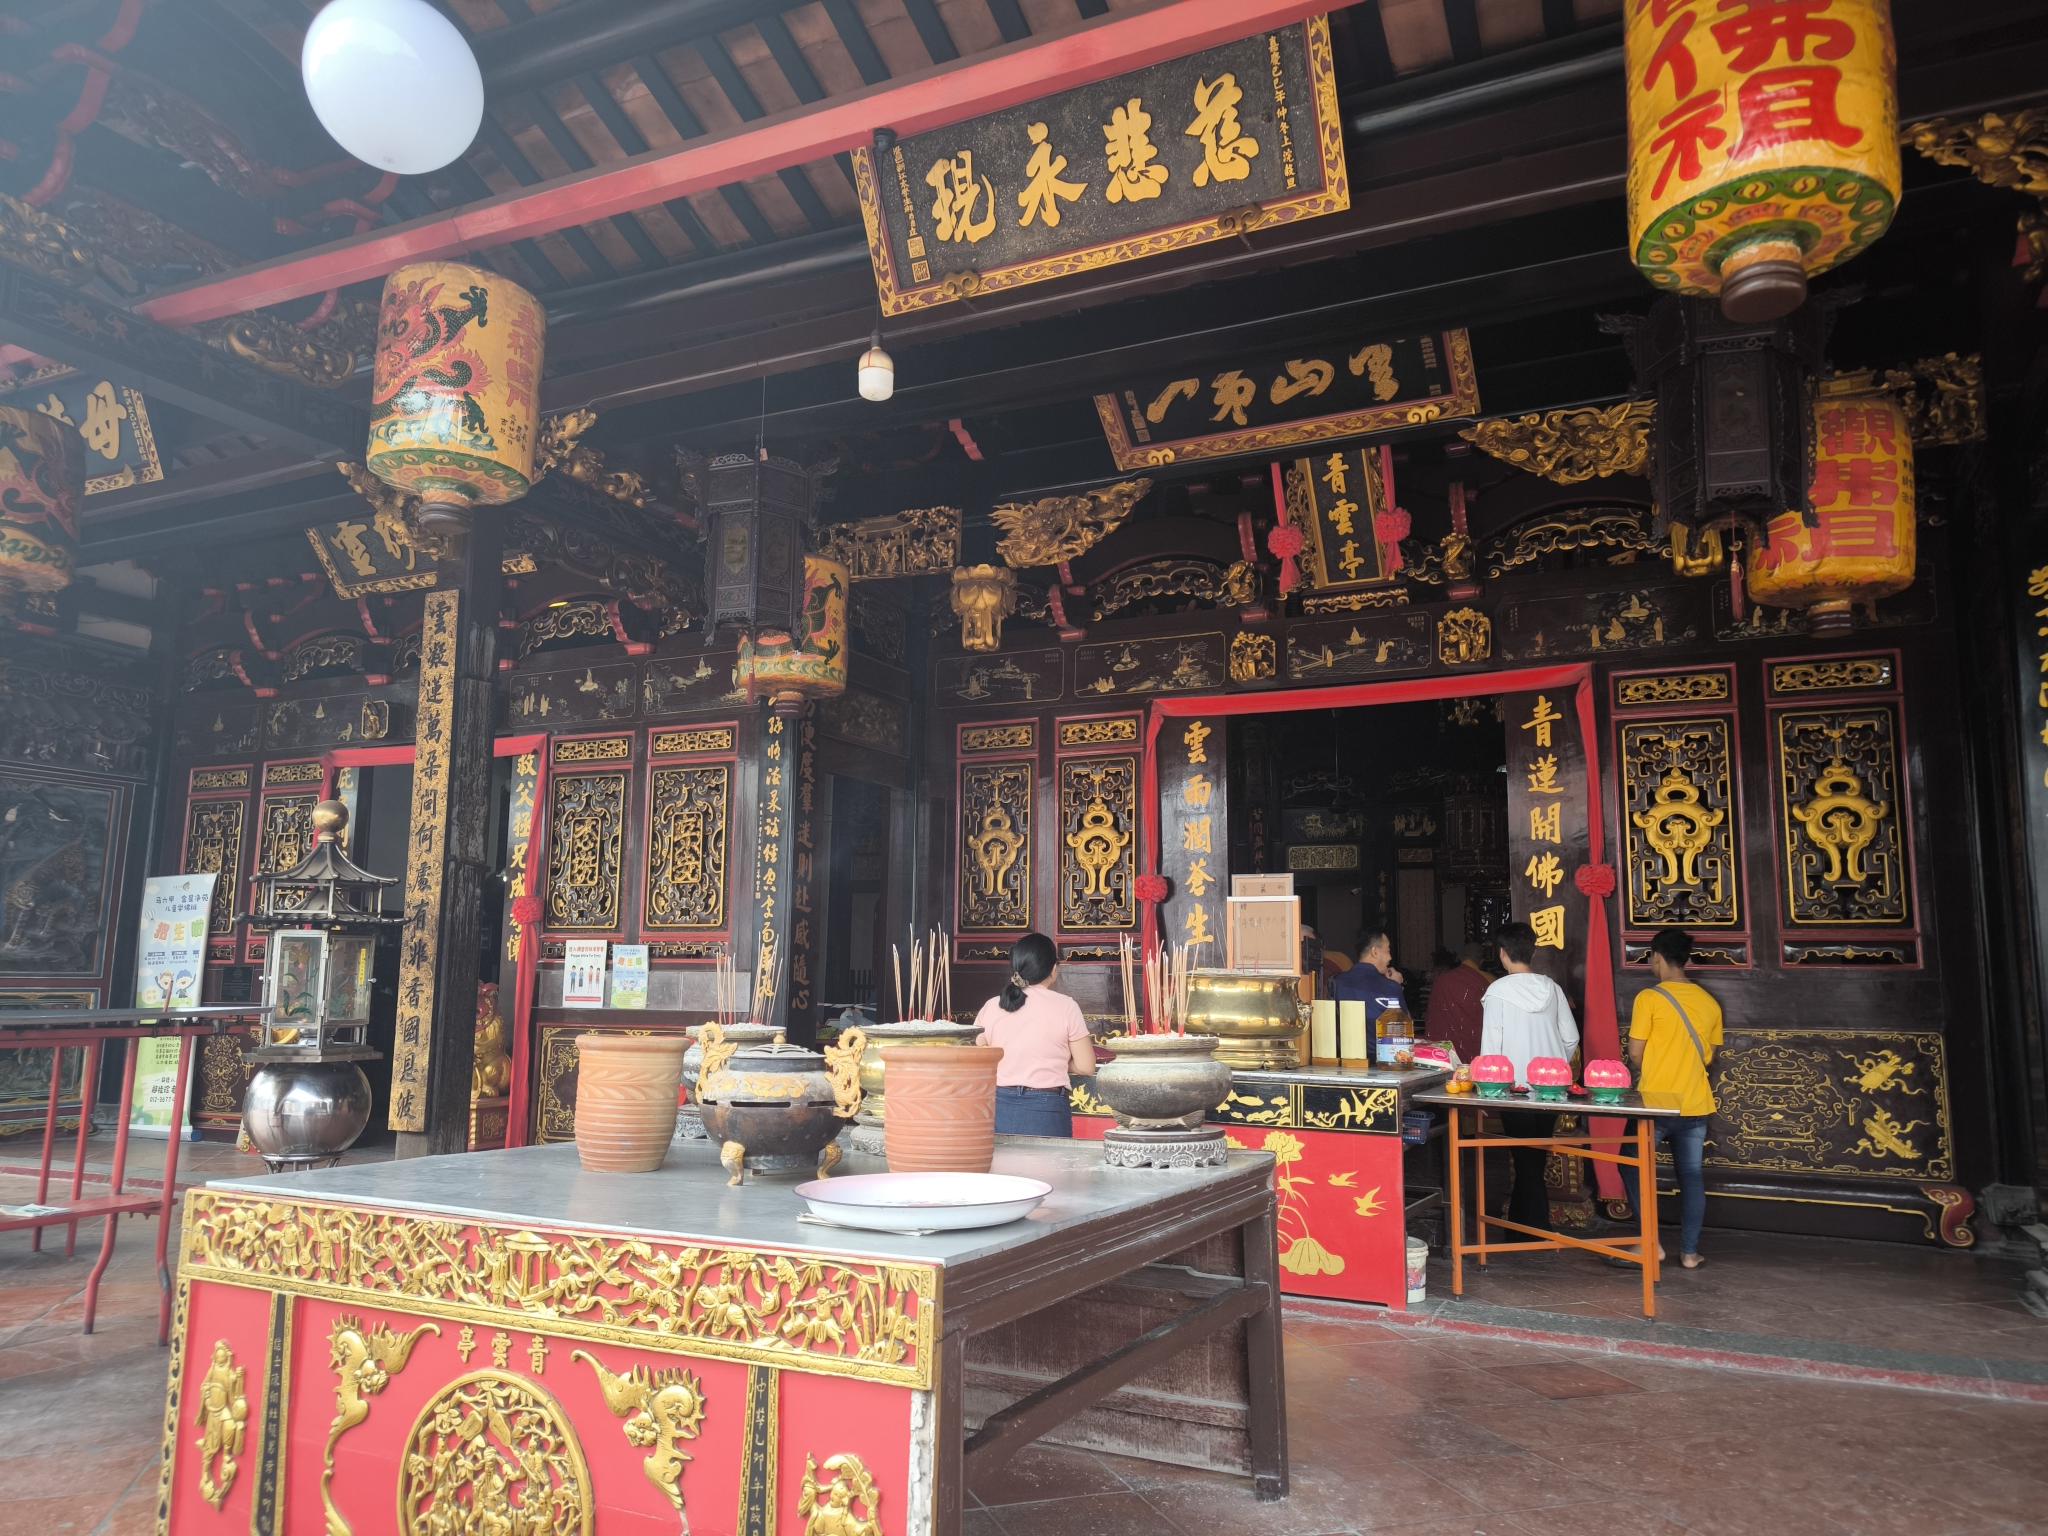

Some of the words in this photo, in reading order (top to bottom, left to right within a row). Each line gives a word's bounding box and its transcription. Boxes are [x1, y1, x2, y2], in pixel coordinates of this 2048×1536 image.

[925, 72, 1260, 243] 慈悲永現
[1322, 451, 1365, 580] 青雲亭
[1183, 720, 1216, 946] 雲雨潤蒼生
[1521, 695, 1566, 951] 青蓮開佛國
[457, 1325, 550, 1375] 青雲亭
